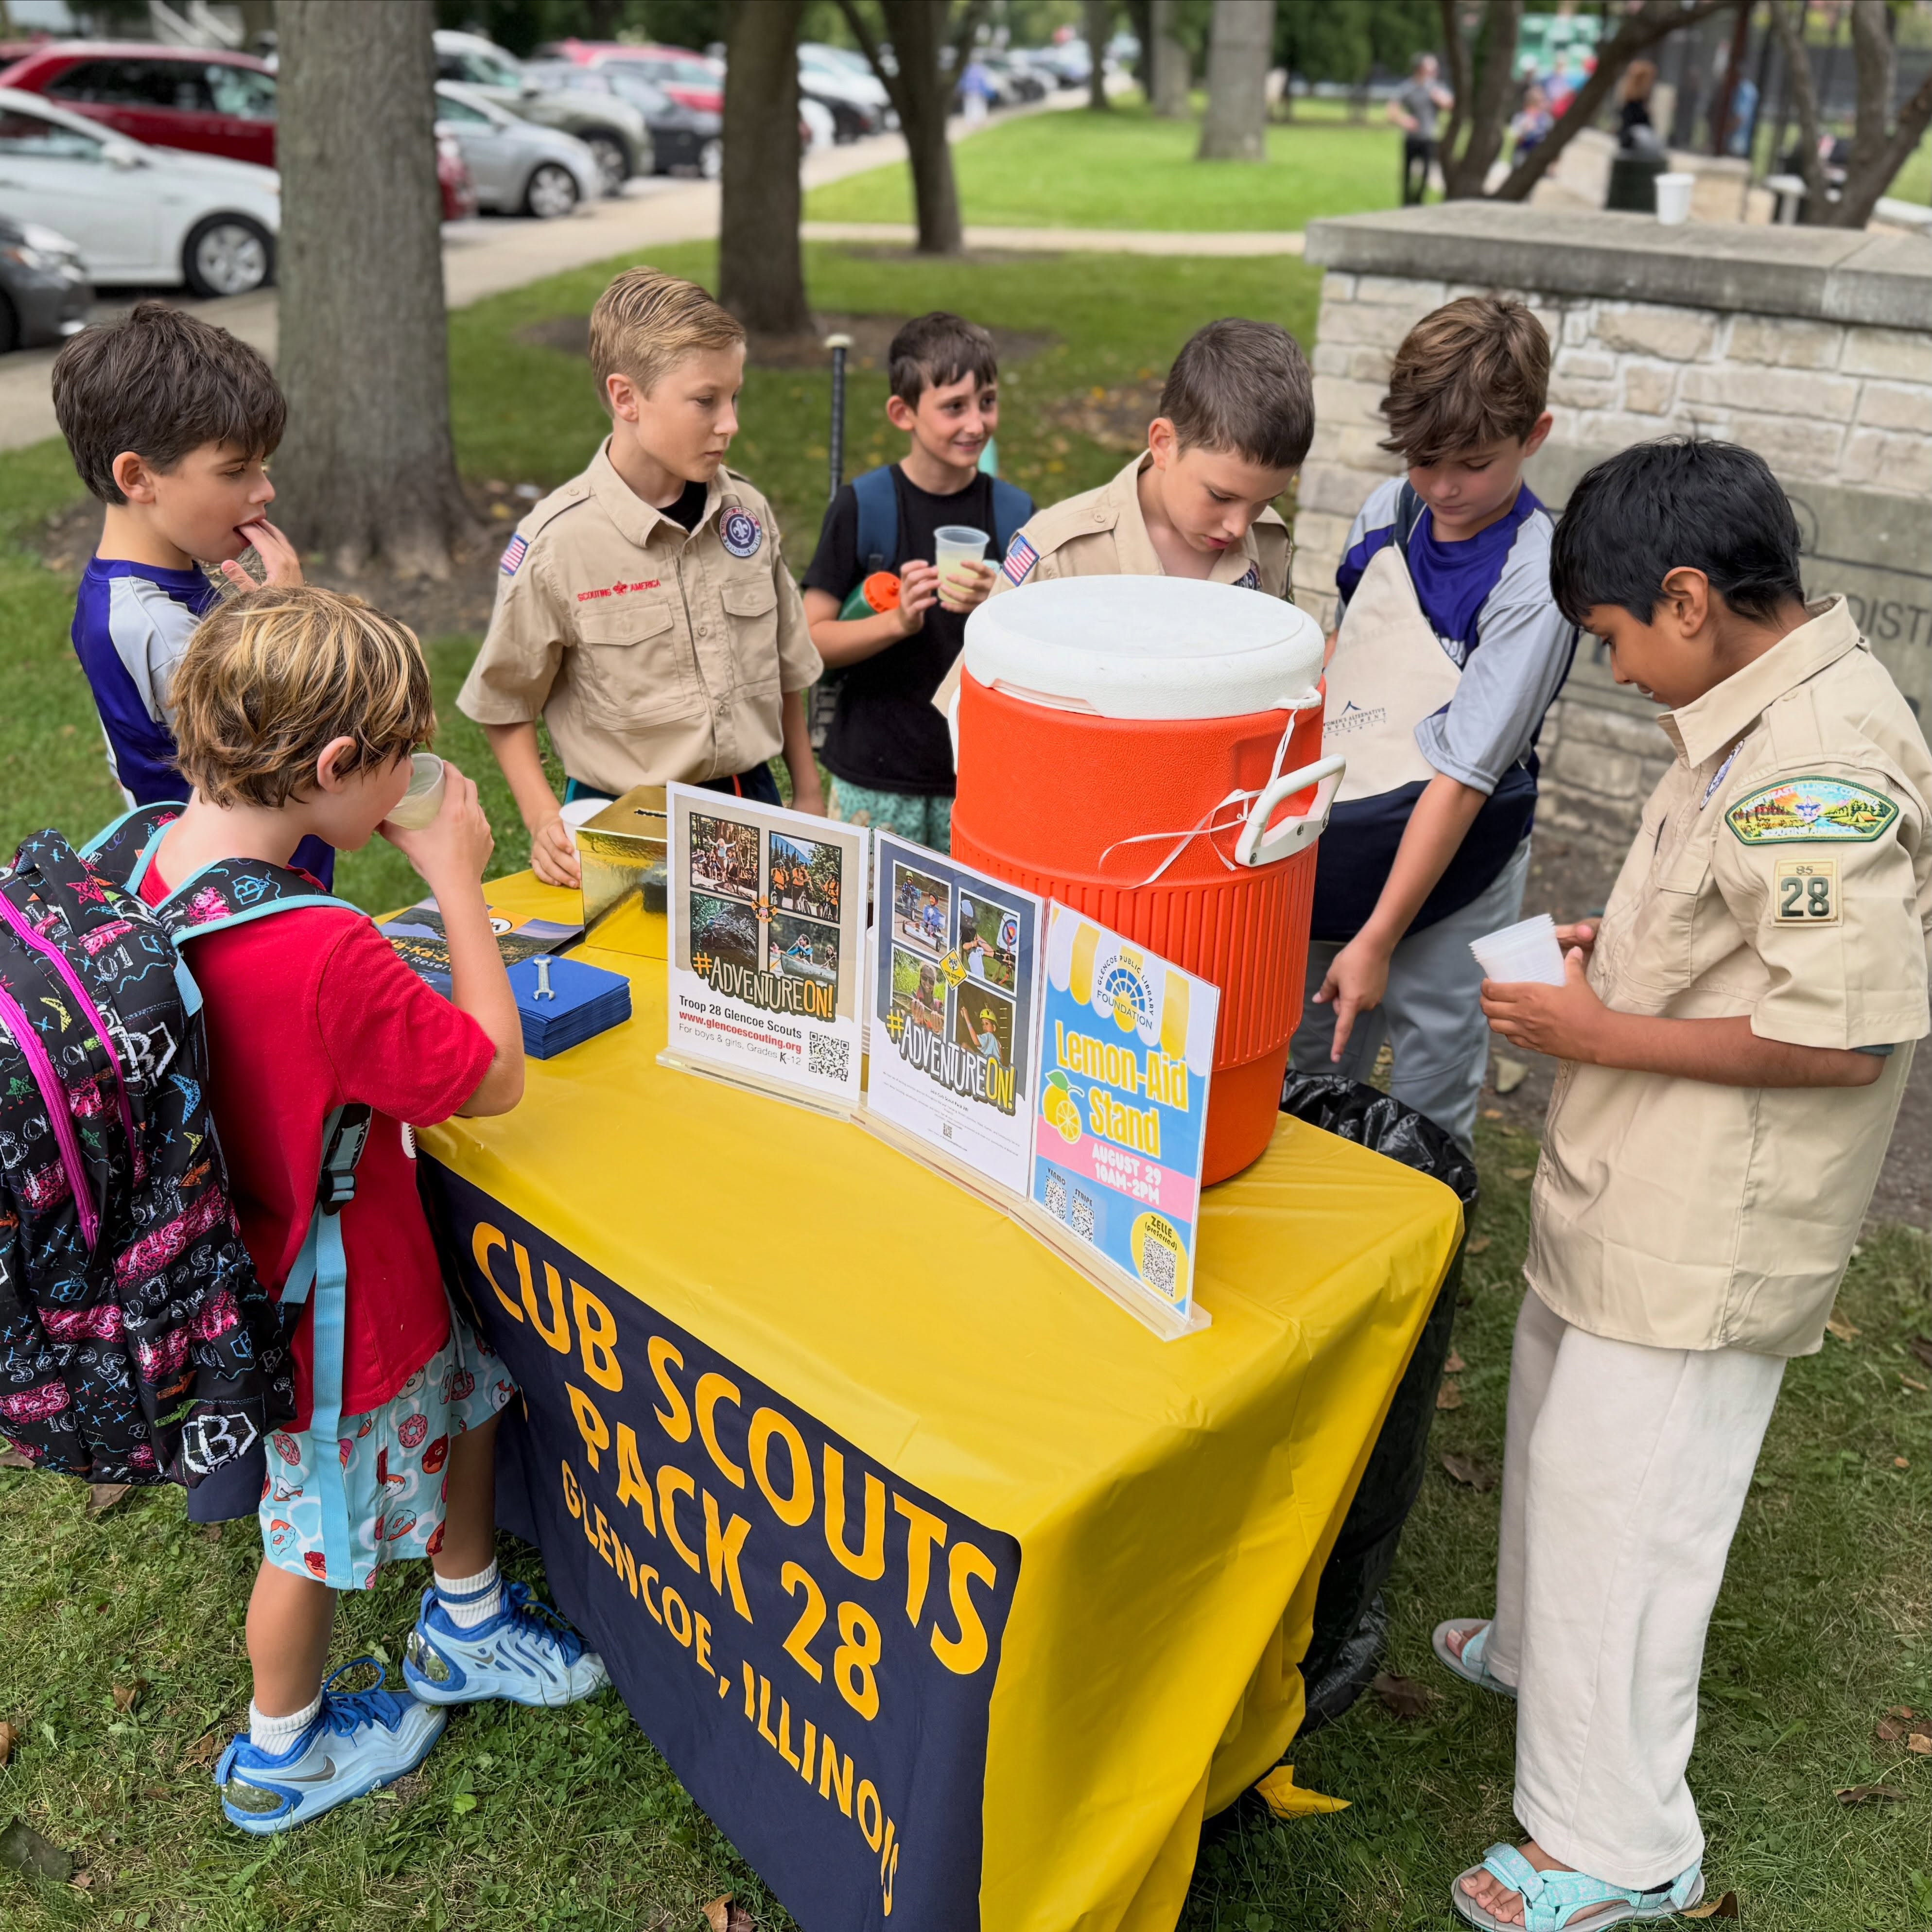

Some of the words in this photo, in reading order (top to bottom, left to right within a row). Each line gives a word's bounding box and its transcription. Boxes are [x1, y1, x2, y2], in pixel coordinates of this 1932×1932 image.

[630, 579, 661, 592] AMERICA
[1796, 866, 1813, 875] 85
[1780, 877, 1829, 917] 28
[411, 956, 451, 972] Reser
[1097, 955, 1118, 986] GLENCOE
[1119, 955, 1141, 974] PUBLIC
[1141, 975, 1154, 1016] LIBRARY
[679, 995, 706, 1013] Troop
[709, 1004, 721, 1016] 28
[724, 1008, 764, 1028] Glencoe
[767, 1020, 802, 1039] Scouts
[1097, 990, 1153, 1031] FOUNDATION
[679, 1011, 802, 1054] www.glencoescouting.org
[679, 1023, 693, 1033] For
[695, 1026, 714, 1041] boys
[717, 1034, 723, 1043] &
[725, 1037, 744, 1050] girls,
[747, 1042, 778, 1059] Grades
[1055, 1019, 1189, 1113] Lemon-Aid
[1088, 1086, 1161, 1160] Stand
[1047, 1166, 1066, 1186] VENMO
[1092, 1142, 1140, 1177] AUGUST
[1145, 1165, 1162, 1186] 29
[1095, 1162, 1160, 1205] 10AM-2PM
[1075, 1188, 1093, 1207] STRIPE
[1145, 1221, 1178, 1251] (preferred)
[1151, 1215, 1172, 1238] ZELLE
[472, 1221, 623, 1392] CUB
[647, 1336, 997, 1675] SCOUTS
[564, 1381, 753, 1624] PACK
[781, 1561, 881, 1721] 28
[561, 1459, 731, 1699] GLENCOE,
